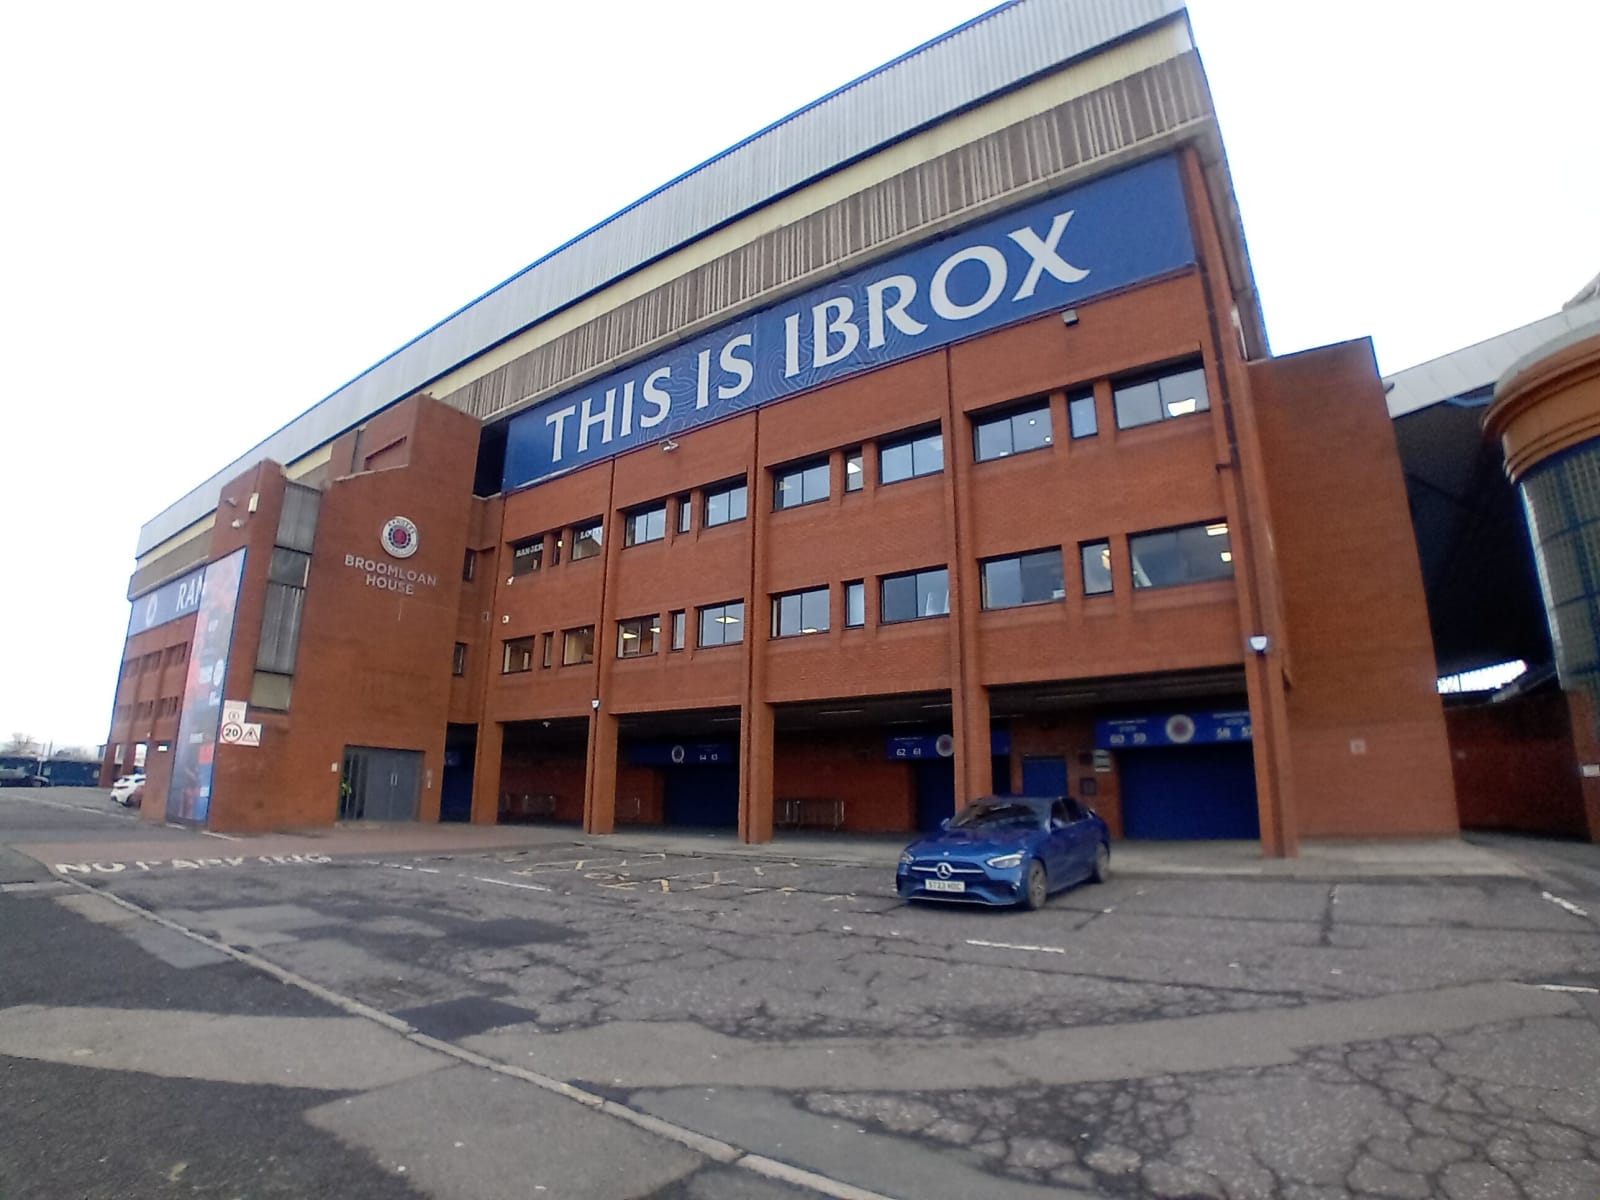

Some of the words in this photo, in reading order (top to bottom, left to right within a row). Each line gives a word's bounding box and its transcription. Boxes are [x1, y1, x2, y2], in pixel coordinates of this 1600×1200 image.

[546, 367, 671, 462] THIS
[696, 334, 754, 410] IS
[785, 210, 1091, 378] IBROX
[344, 554, 437, 586] BROOMLOAN
[366, 574, 414, 595] HOUSE
[225, 728, 239, 737] 20
[896, 748, 906, 756] 62
[913, 747, 921, 755] 61
